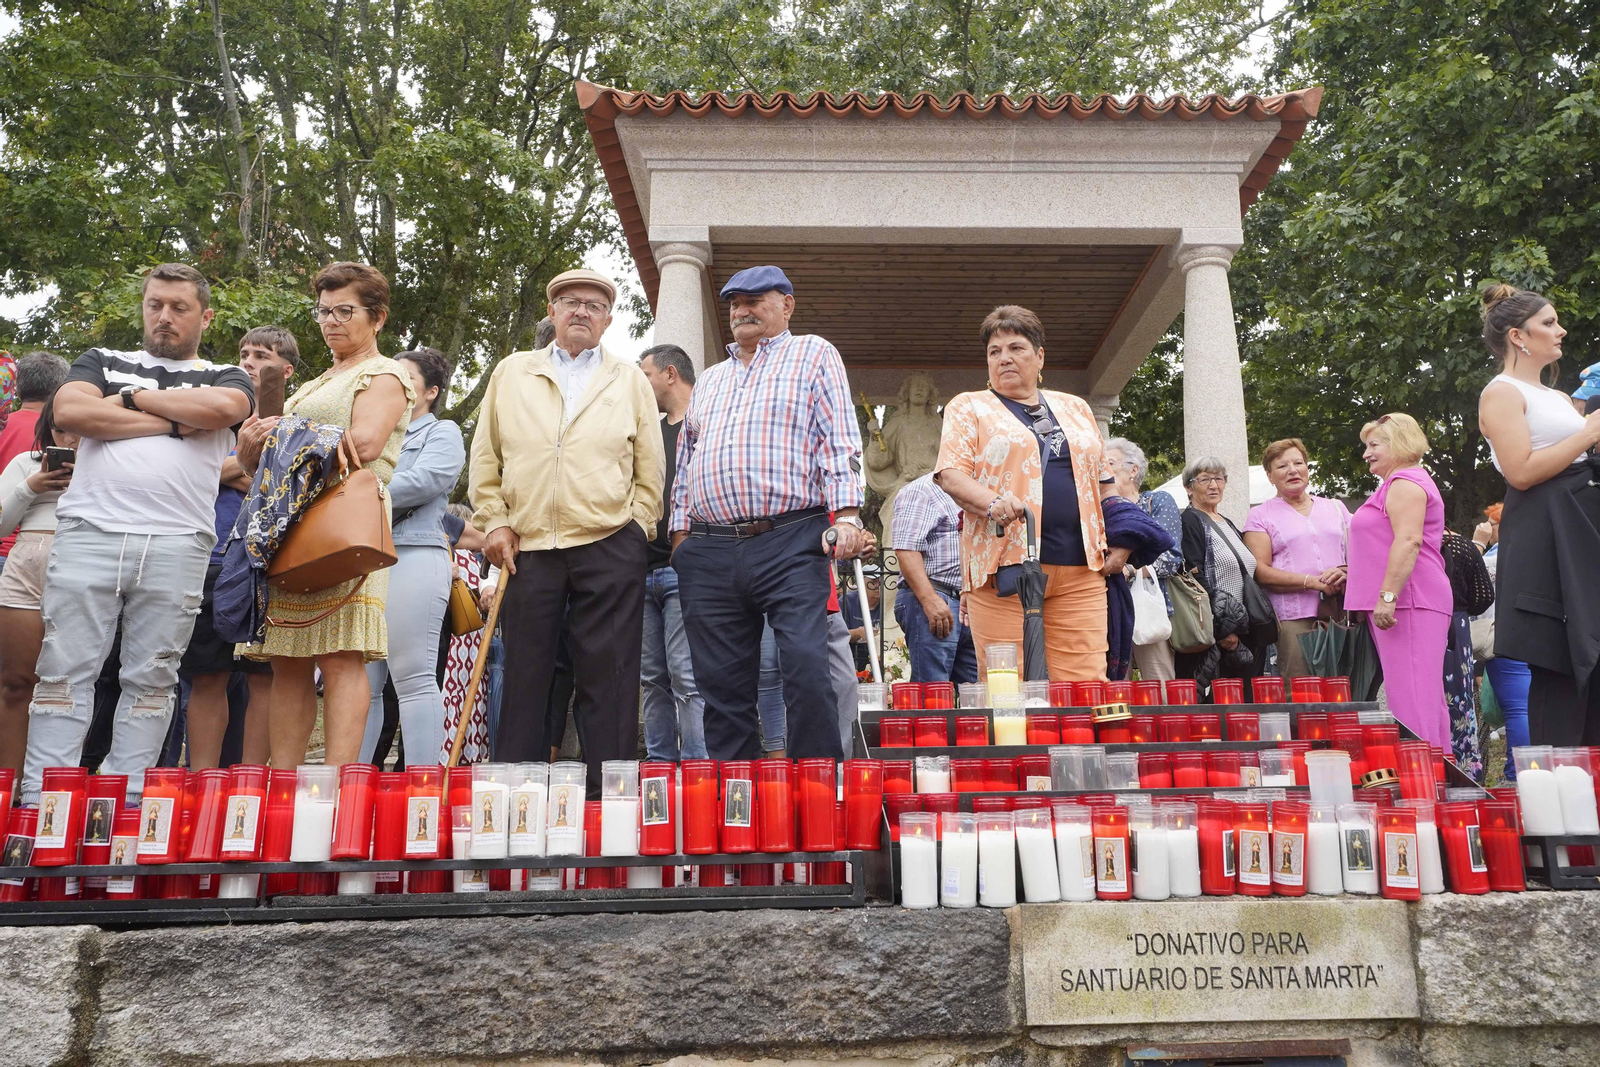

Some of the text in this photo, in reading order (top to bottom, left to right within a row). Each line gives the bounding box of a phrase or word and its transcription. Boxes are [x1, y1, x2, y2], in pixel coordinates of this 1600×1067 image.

[1126, 931, 1309, 956] “DONATIVO PARA
[1060, 964, 1384, 992] SANTUARIO DE SANTA MARTA”
